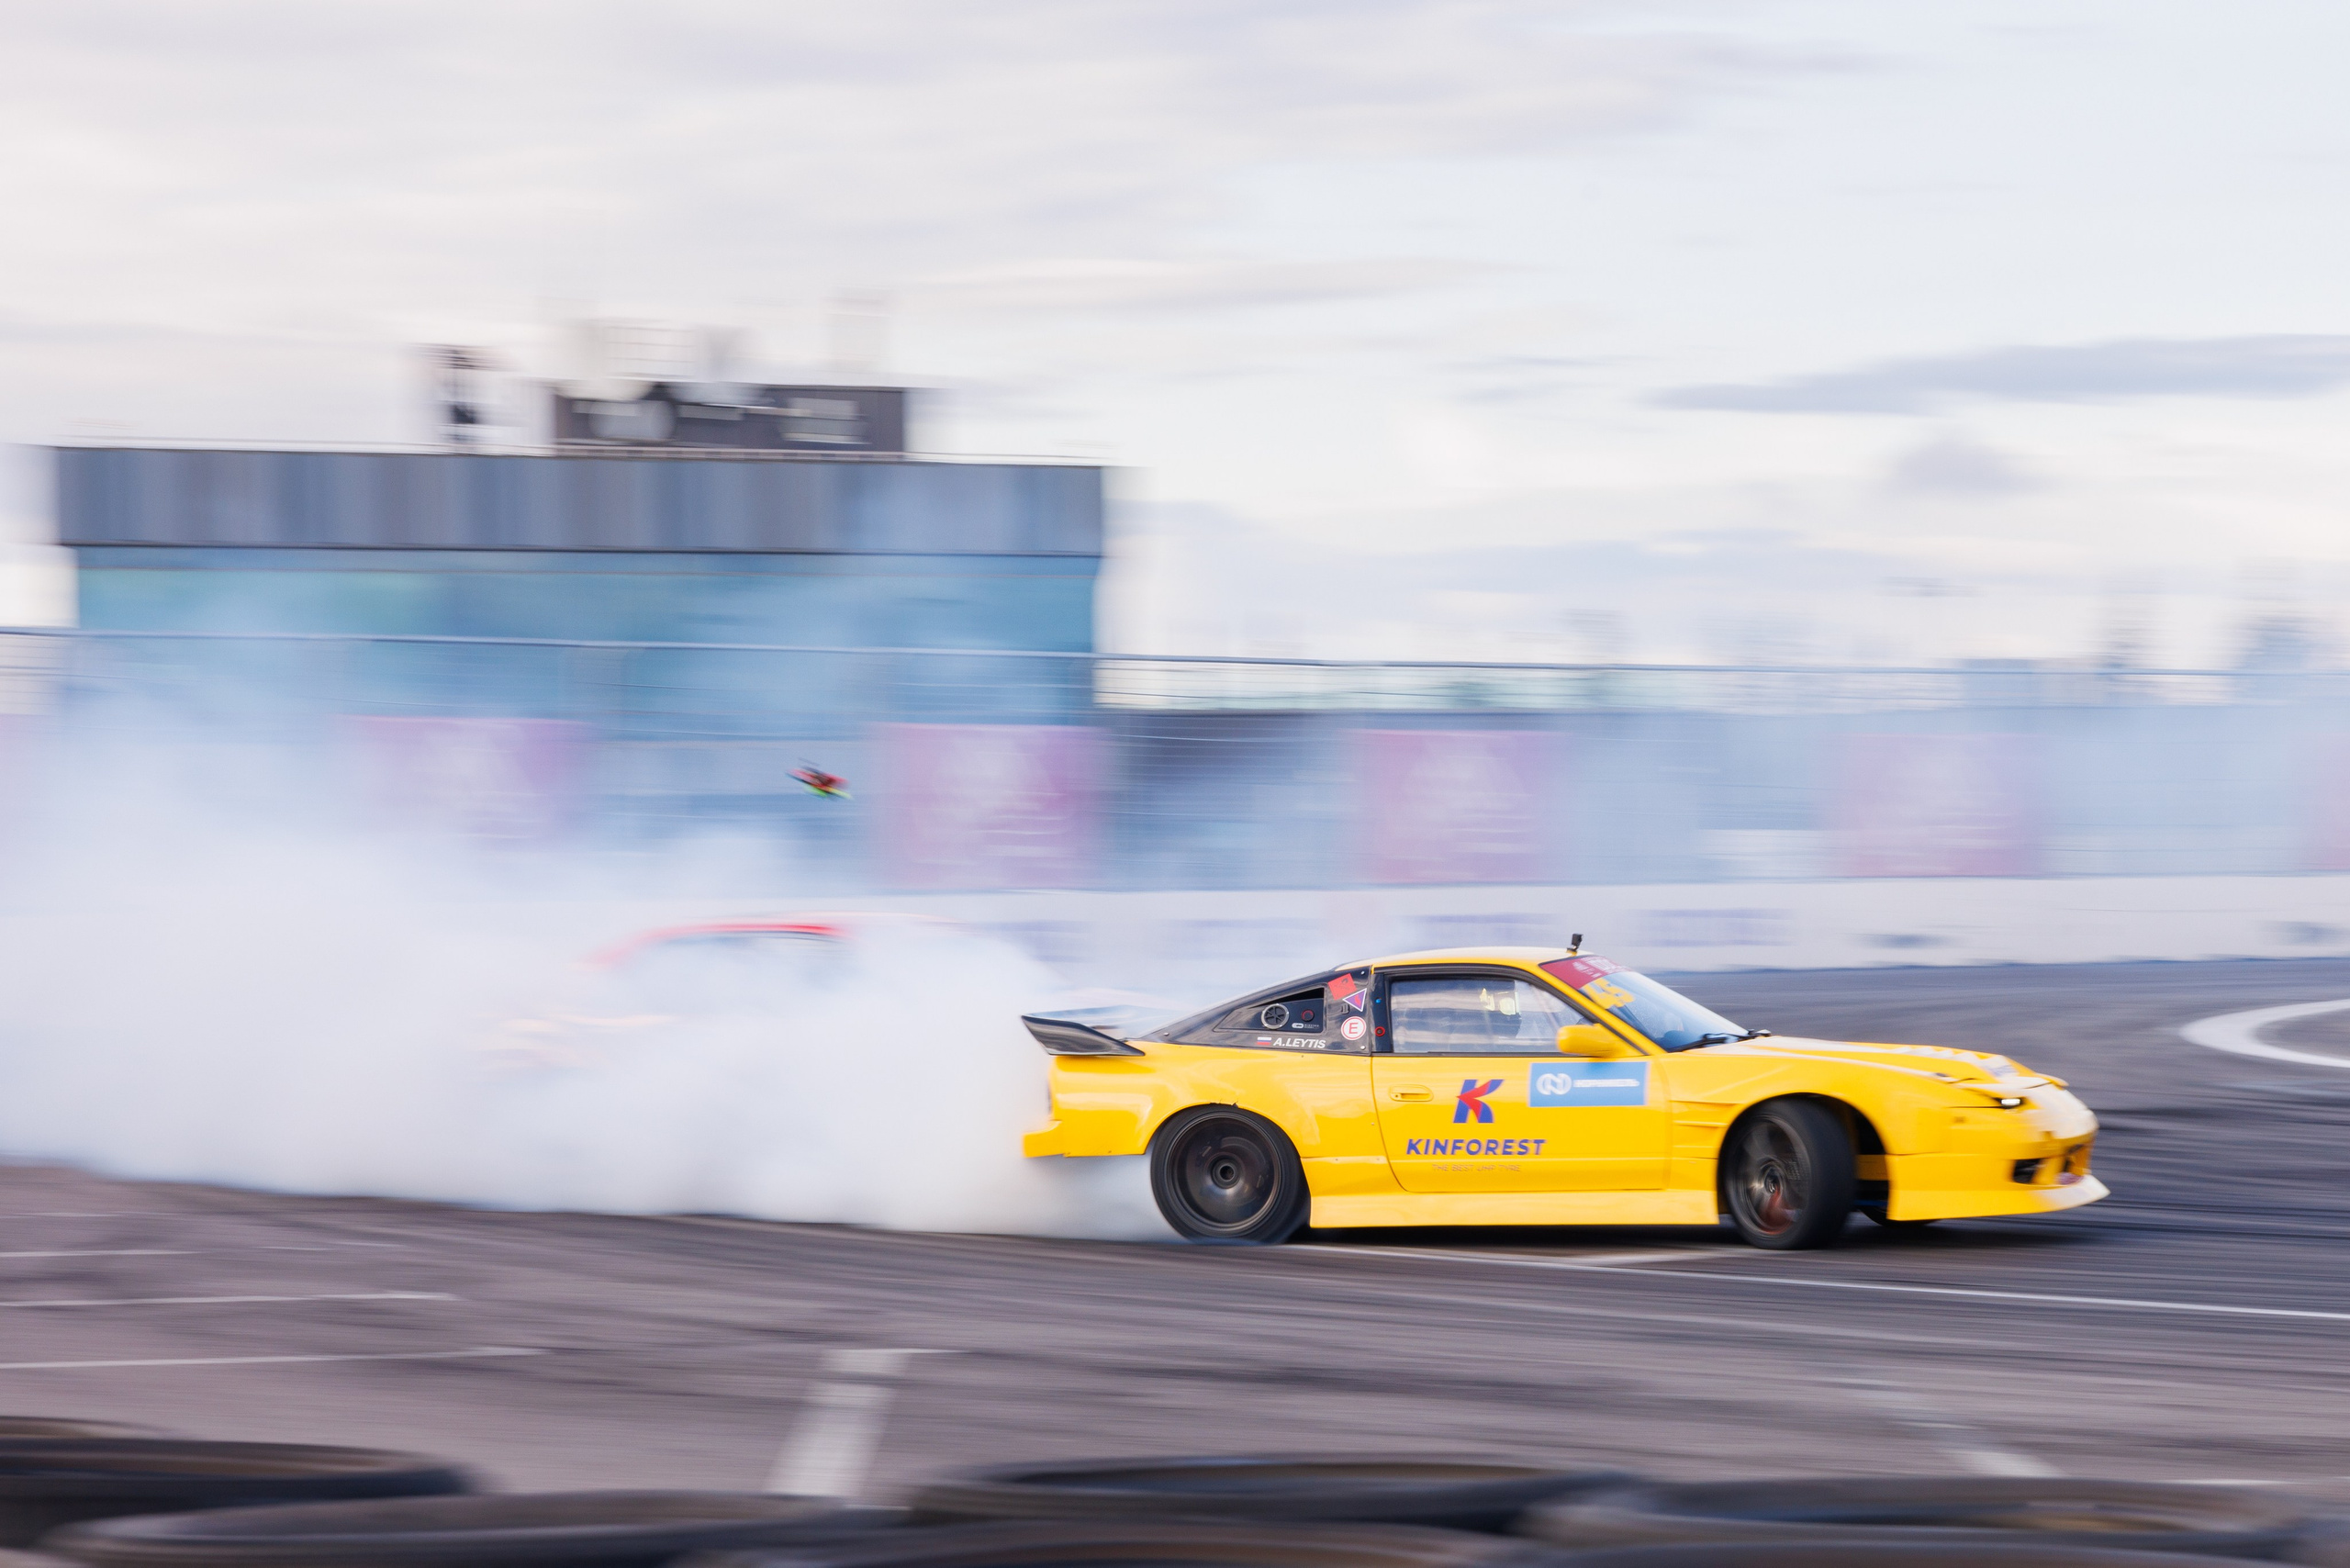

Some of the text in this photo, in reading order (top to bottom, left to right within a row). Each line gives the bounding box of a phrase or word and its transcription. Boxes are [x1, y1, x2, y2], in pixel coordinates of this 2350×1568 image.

[1348, 1022, 1359, 1035] E
[1273, 1037, 1326, 1048] A.LEYTIS
[1406, 1138, 1547, 1155] KINFOREST
[1432, 1163, 1449, 1171] THE
[1451, 1163, 1474, 1171] BEST
[1498, 1163, 1521, 1171] TYRE
